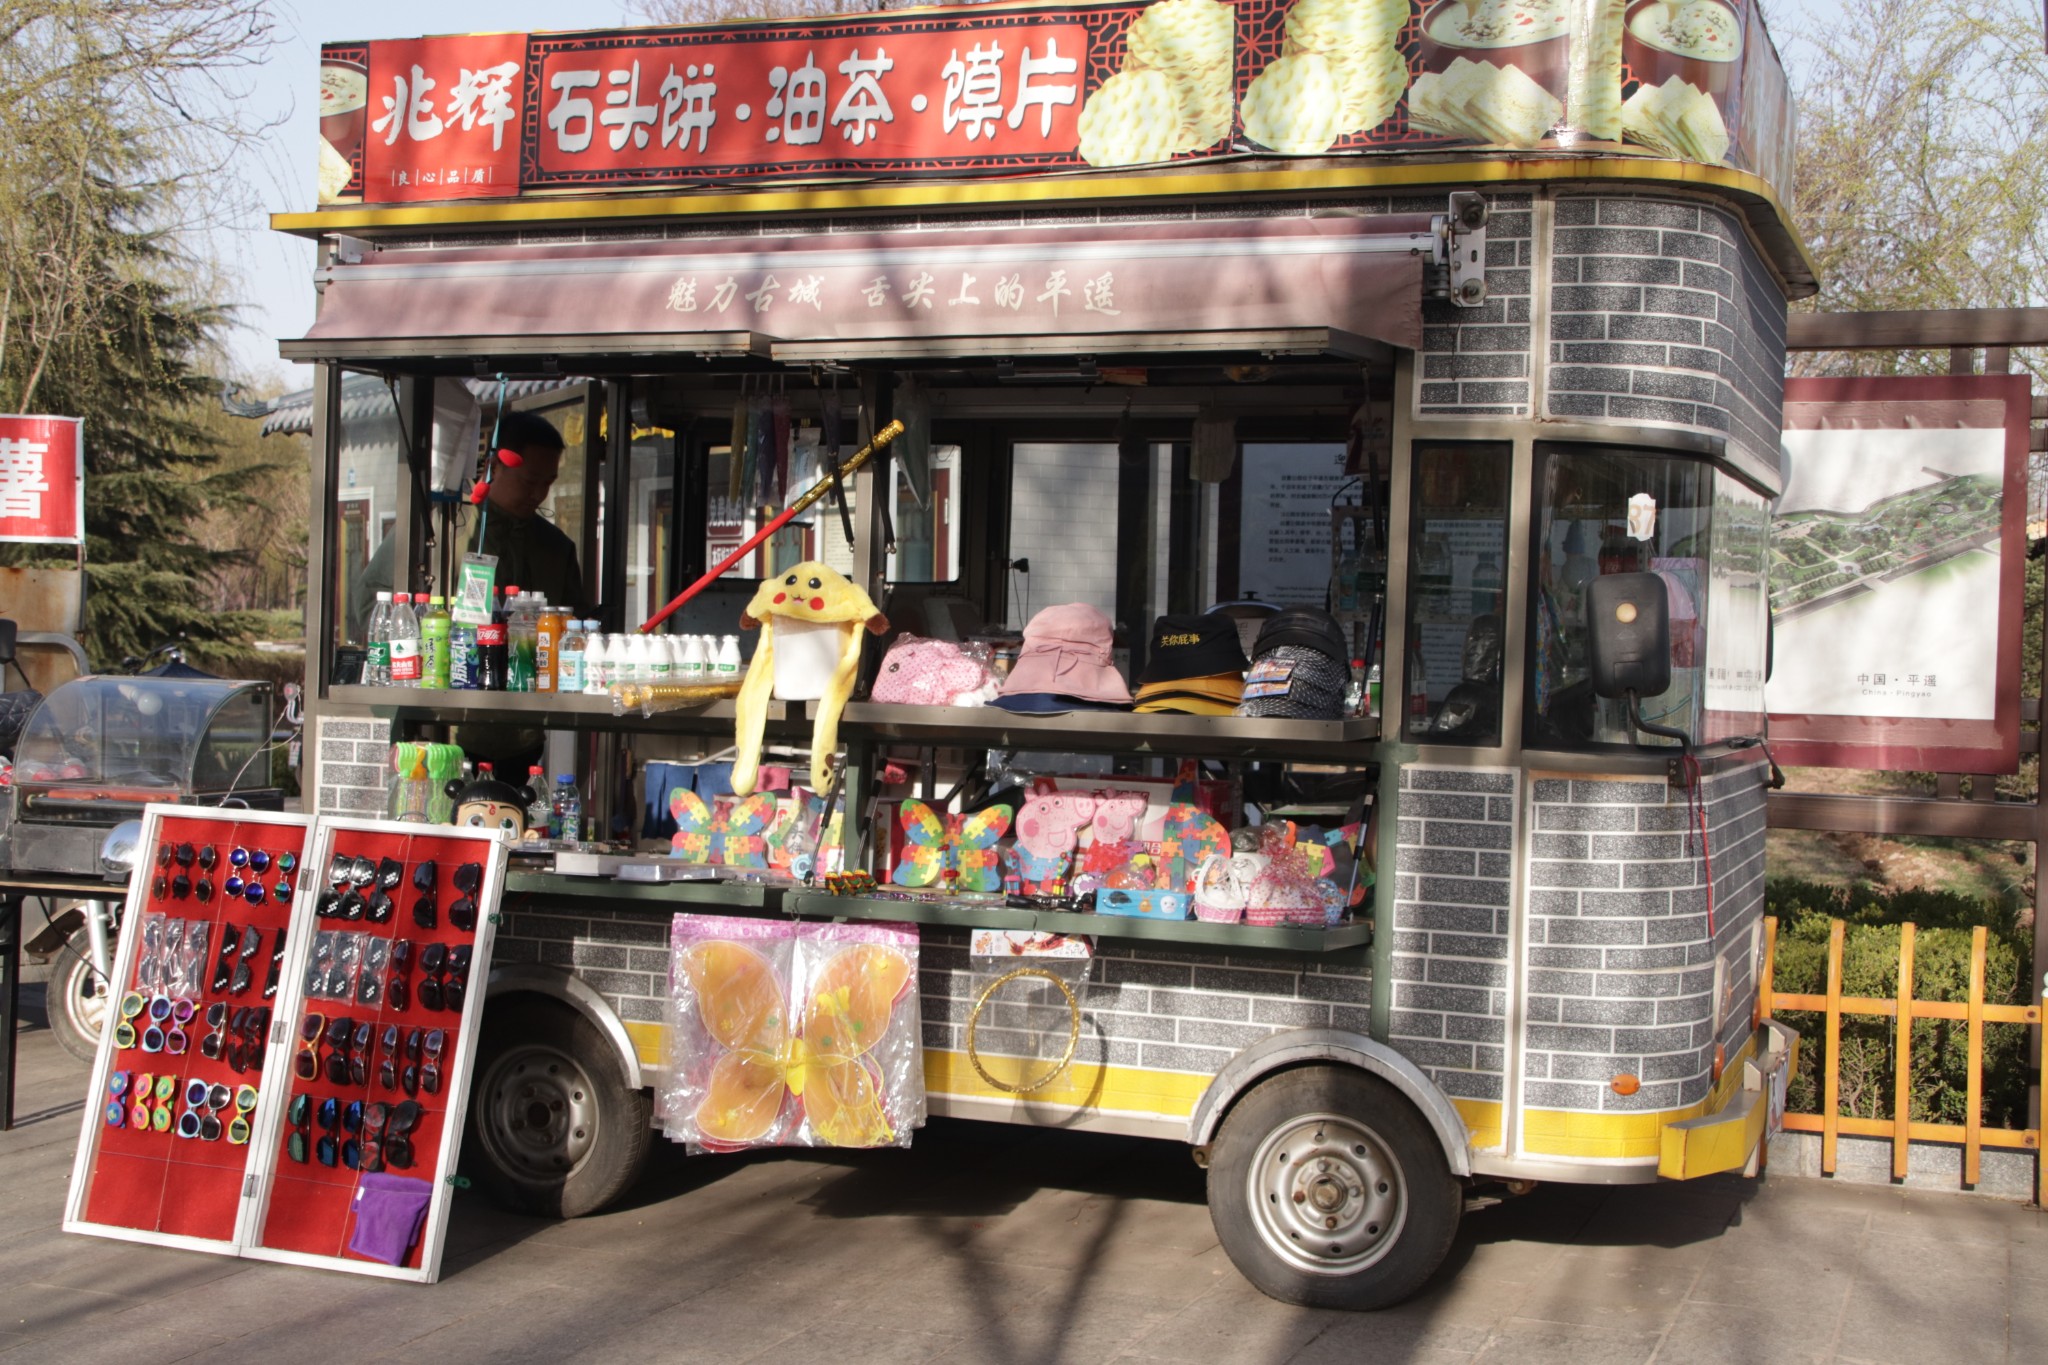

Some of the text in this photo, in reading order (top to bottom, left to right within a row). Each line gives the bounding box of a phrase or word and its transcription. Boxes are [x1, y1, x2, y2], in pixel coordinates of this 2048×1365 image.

[371, 61, 520, 152] 兆辉
[665, 270, 1123, 318] 魅力古城 舌尖上的平遥
[1160, 633, 1200, 648] 关你屁事
